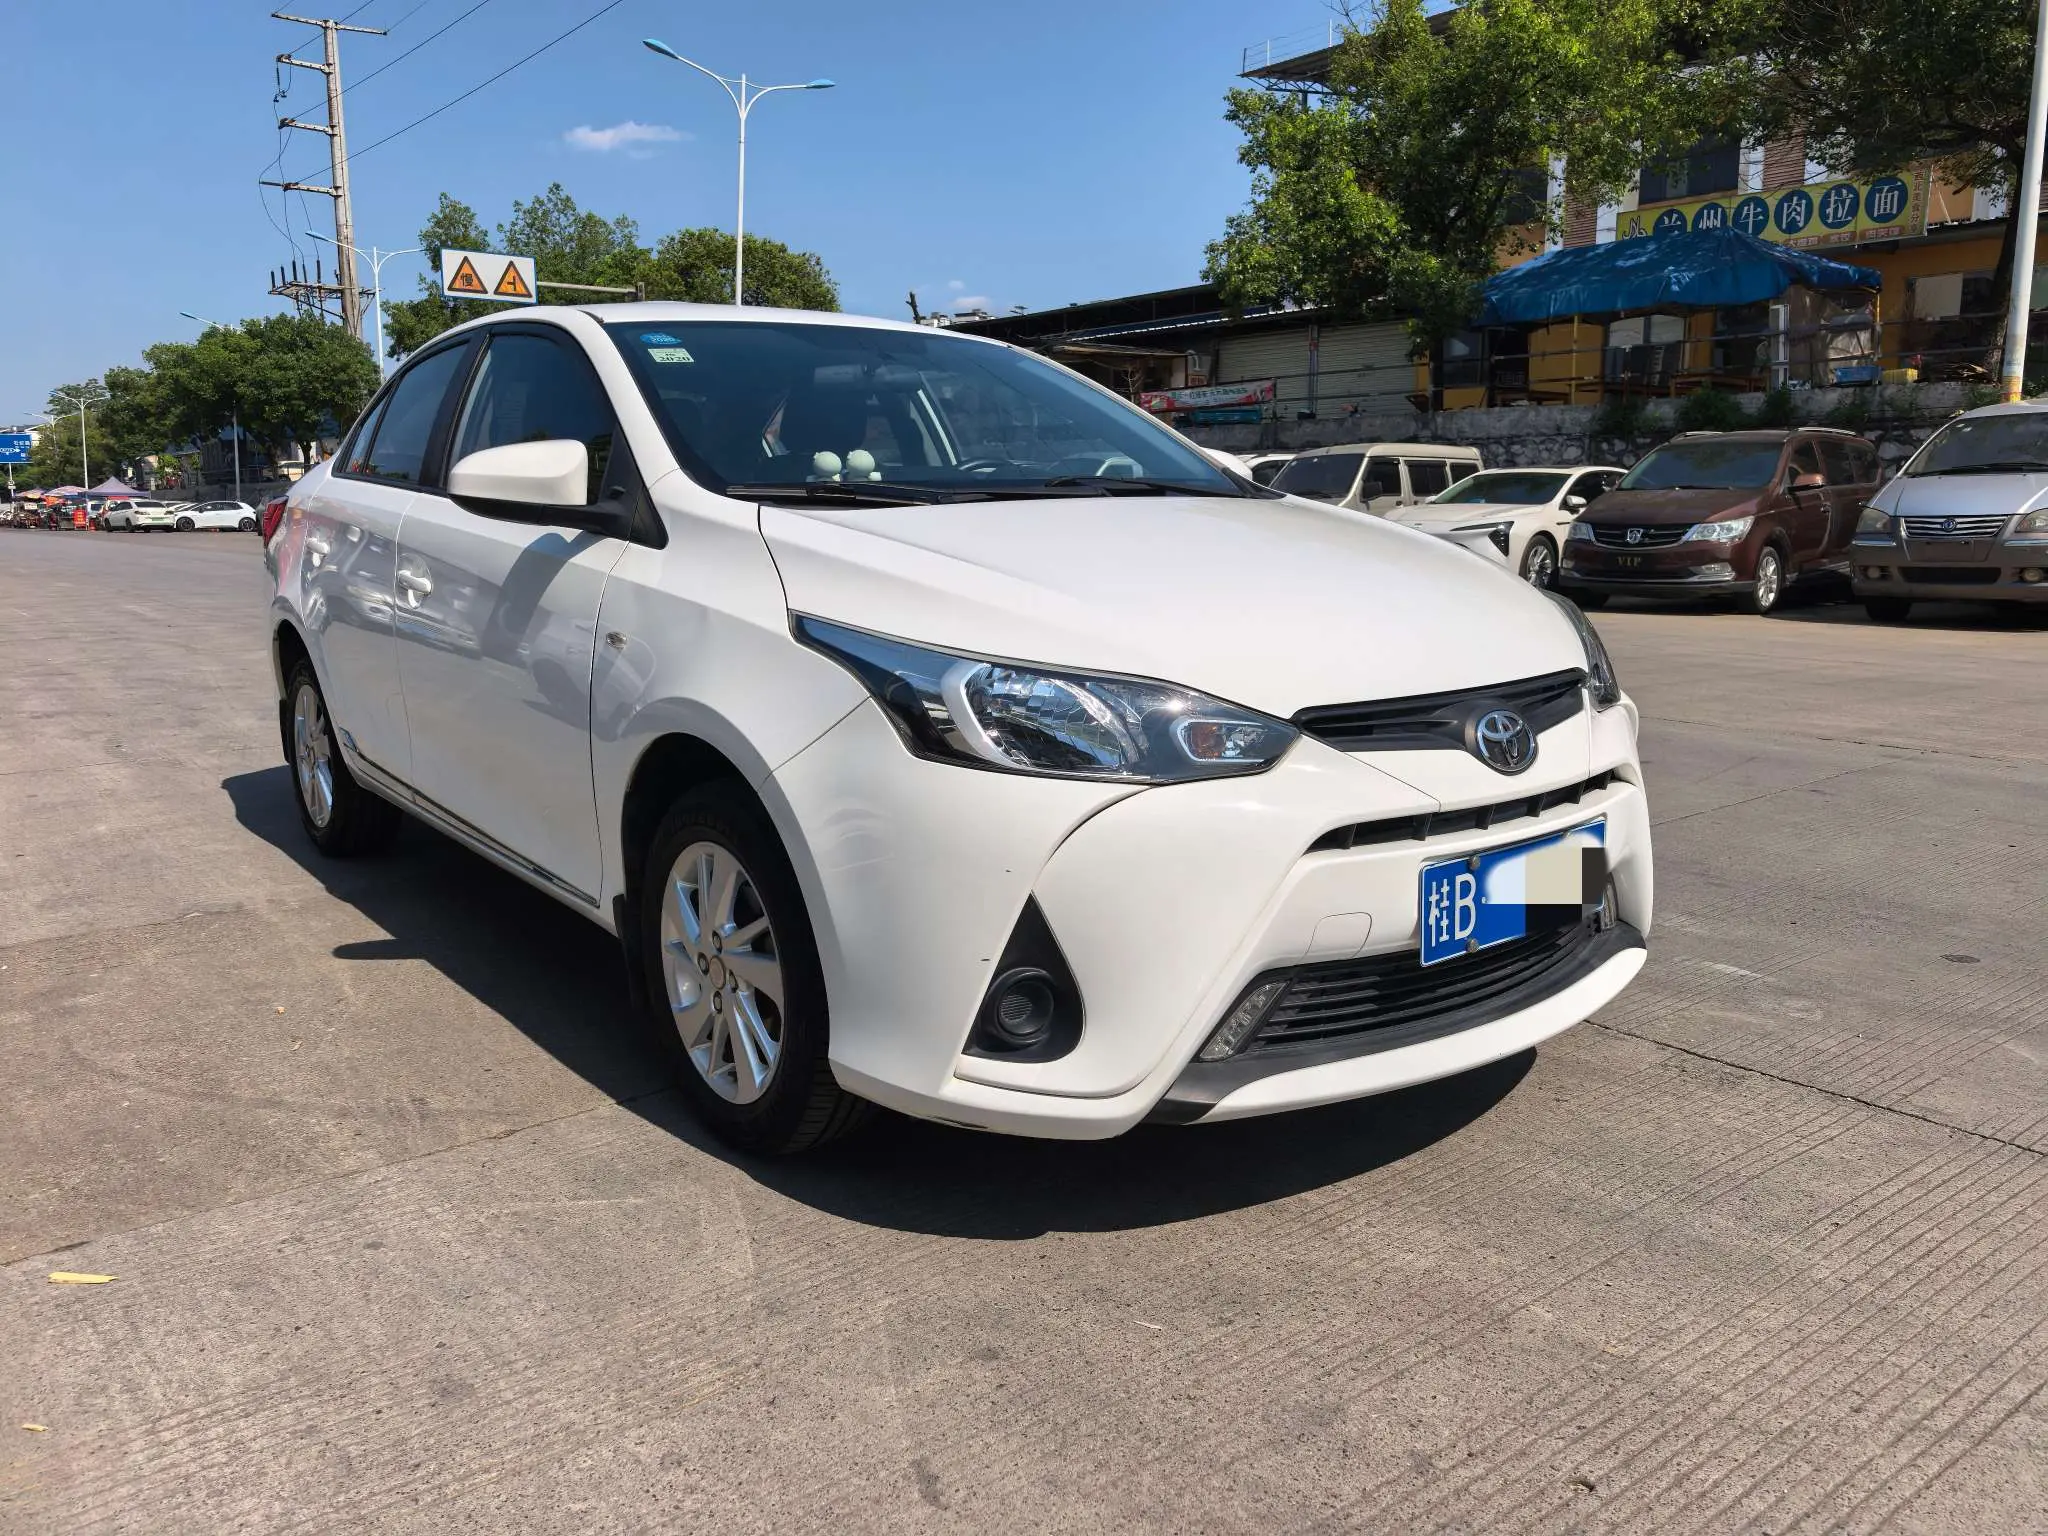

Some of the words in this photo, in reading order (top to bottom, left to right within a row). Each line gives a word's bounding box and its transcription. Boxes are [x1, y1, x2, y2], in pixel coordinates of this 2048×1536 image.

[1659, 181, 1902, 234] 兰州牛肉拉面
[460, 272, 474, 287] 慢
[1616, 556, 1642, 568] VIP
